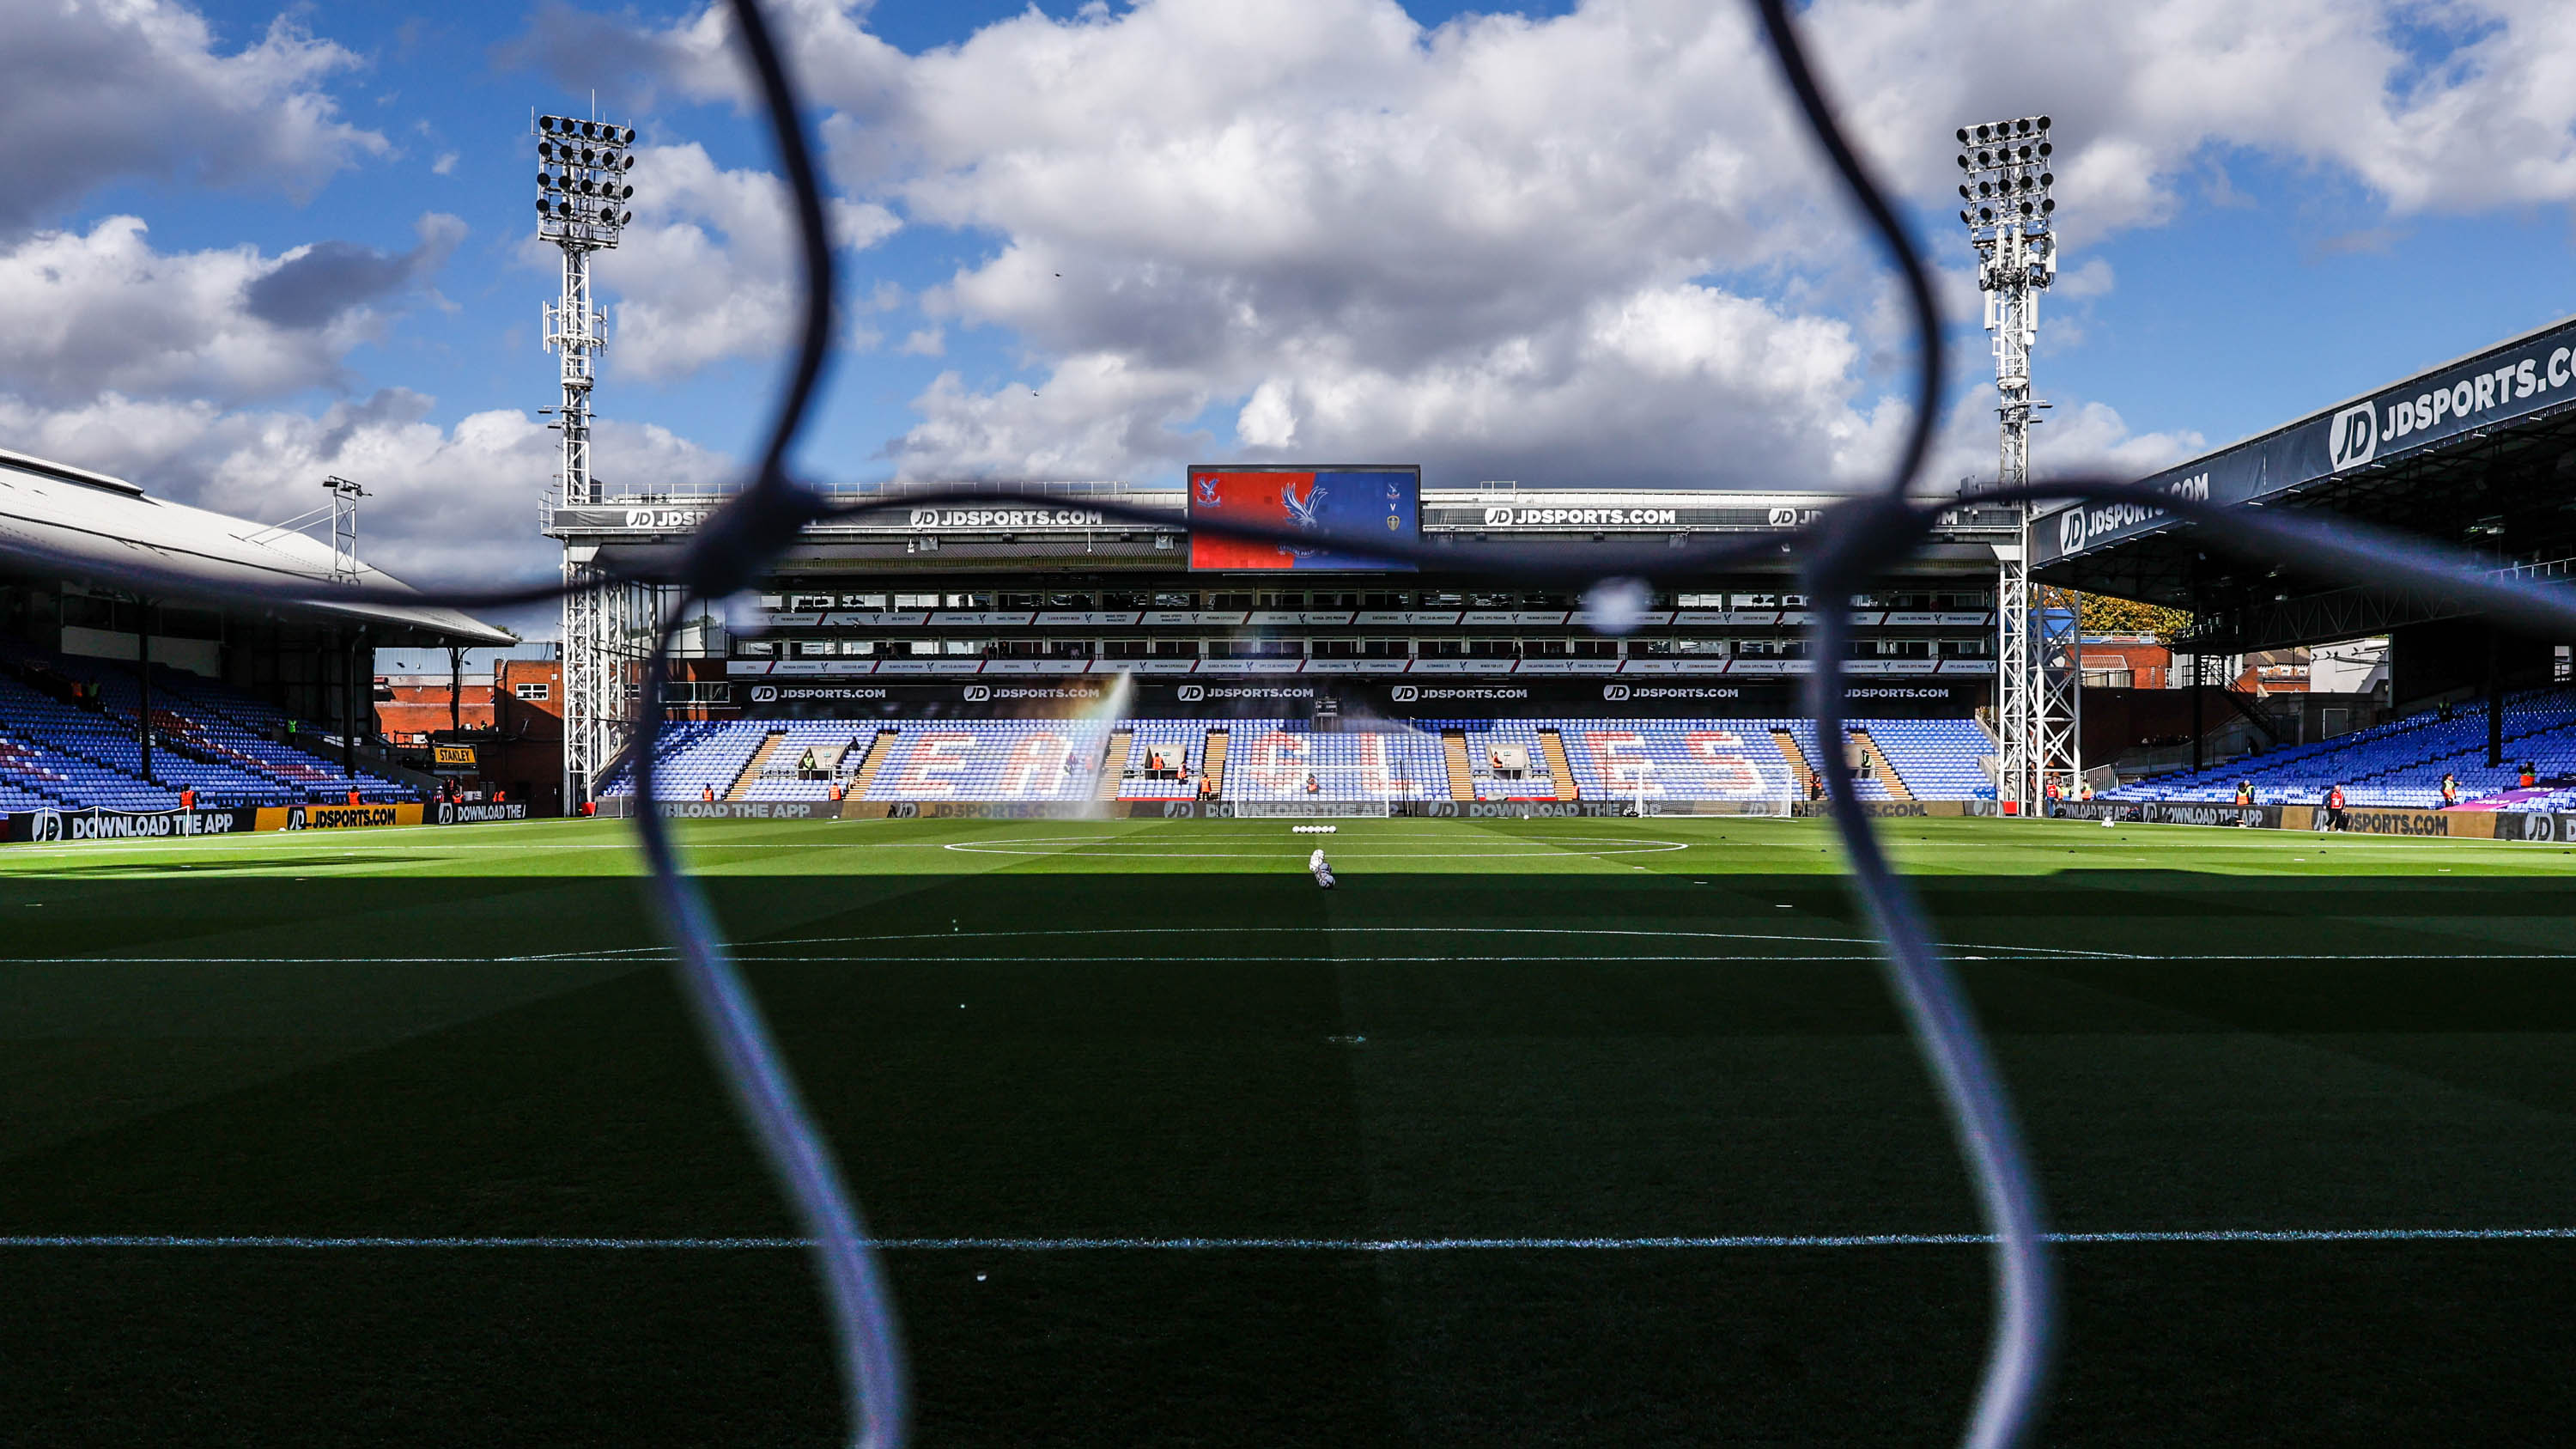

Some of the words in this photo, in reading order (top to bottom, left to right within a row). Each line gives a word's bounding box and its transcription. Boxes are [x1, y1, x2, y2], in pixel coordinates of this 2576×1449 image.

[2381, 342, 2576, 441] JDSPORTS.C
[941, 511, 1103, 525] JDSPORTS.COM
[1516, 510, 1676, 524] JDSPORTS.COM
[780, 689, 886, 698] JDSPORTS.COM
[993, 688, 1100, 698] JDSPORTS.COM
[1206, 688, 1314, 697] JDSPORTS.COM
[1420, 688, 1528, 697] JDSPORTS.COM
[1632, 688, 1739, 697] JDSPORTS.COM
[1844, 689, 1949, 697] JDSPORTS.COM
[440, 749, 470, 761] STANLEY
[458, 804, 506, 822] DOWNLOAD
[506, 804, 521, 819] THE
[732, 803, 769, 818] THE
[773, 803, 811, 818] APP
[1469, 803, 1580, 818] DOWNLOAD
[1583, 803, 1620, 817] THE
[313, 808, 397, 829] JDSPORTS.COM
[72, 815, 170, 839] DOWNLOAD
[204, 813, 234, 834] APP
